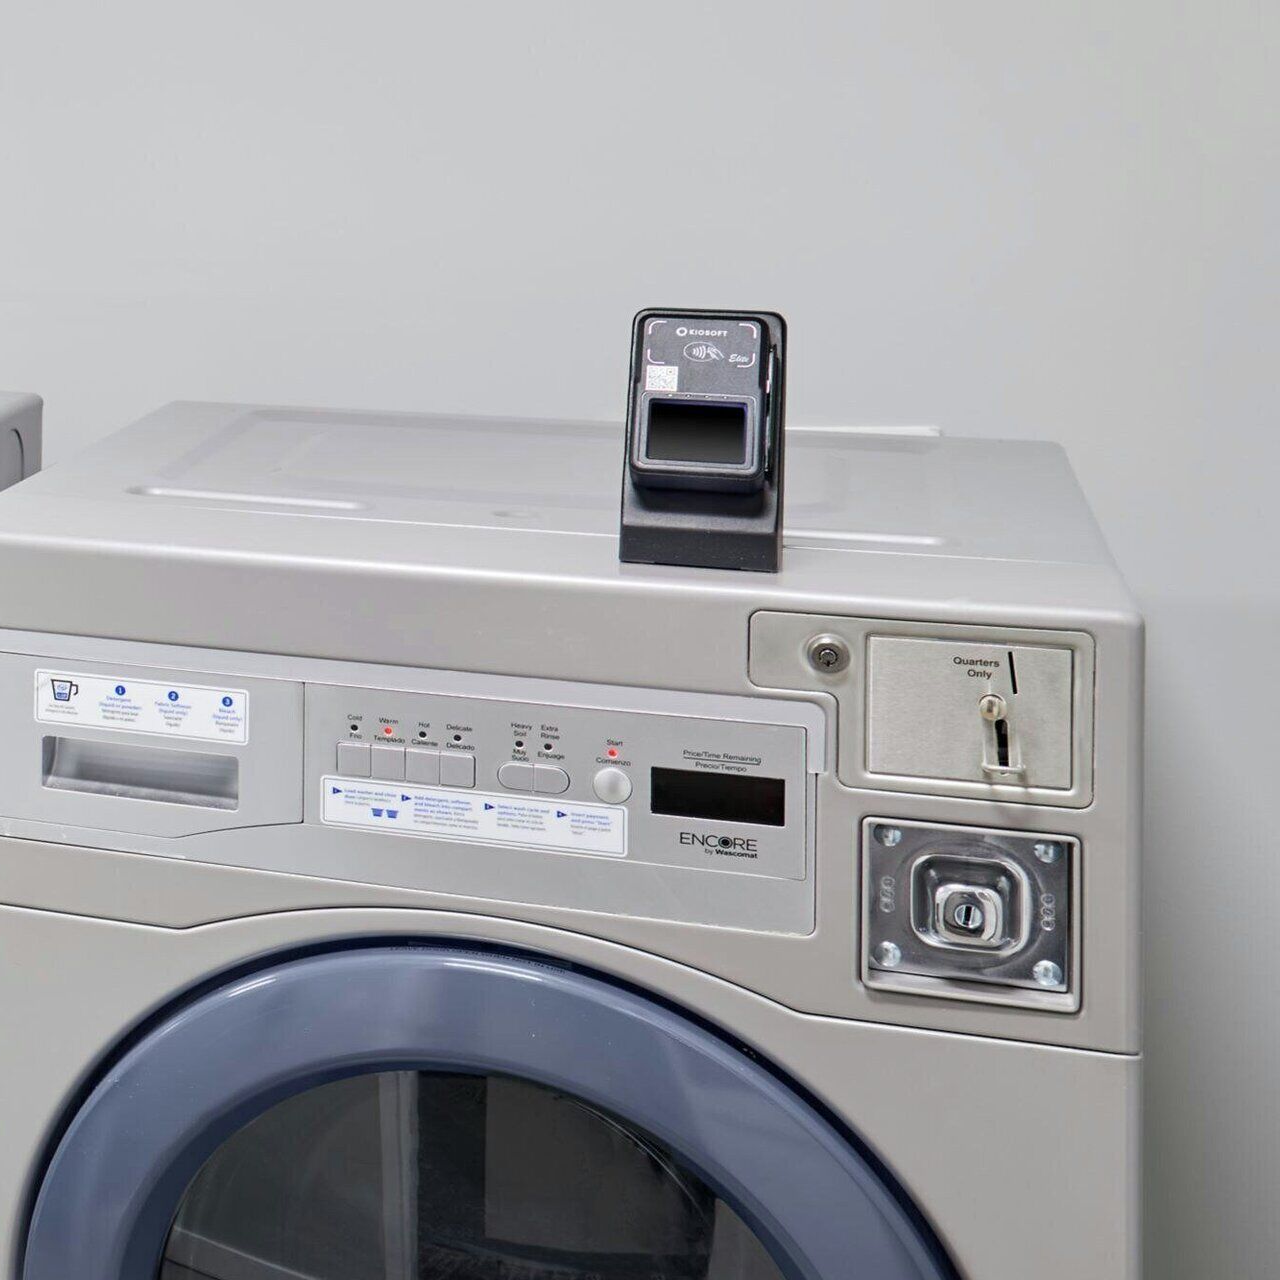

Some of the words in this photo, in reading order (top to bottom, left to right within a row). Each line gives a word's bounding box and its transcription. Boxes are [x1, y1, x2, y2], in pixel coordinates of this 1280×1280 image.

[689, 328, 728, 337] KIOSOFT
[728, 353, 750, 363] Elite
[953, 656, 1000, 668] Quarters
[967, 669, 993, 681] Only
[347, 714, 363, 722] Cold
[378, 717, 399, 725] Warm
[446, 724, 473, 733] Delicate
[511, 722, 533, 731] Heavy
[541, 725, 559, 733] Extra
[374, 735, 405, 744] Templado
[540, 732, 560, 741] Rinse
[411, 738, 438, 747] Caliente
[446, 742, 475, 751] Delicado
[606, 739, 624, 747] Start
[683, 749, 721, 760] Price/Time
[722, 752, 762, 764] Remaining
[596, 757, 631, 767] Comienzo
[695, 761, 747, 773] Precio/Tiempo
[680, 832, 758, 852] ENCORE
[705, 848, 714, 856] by
[715, 849, 758, 860] Wascomat
